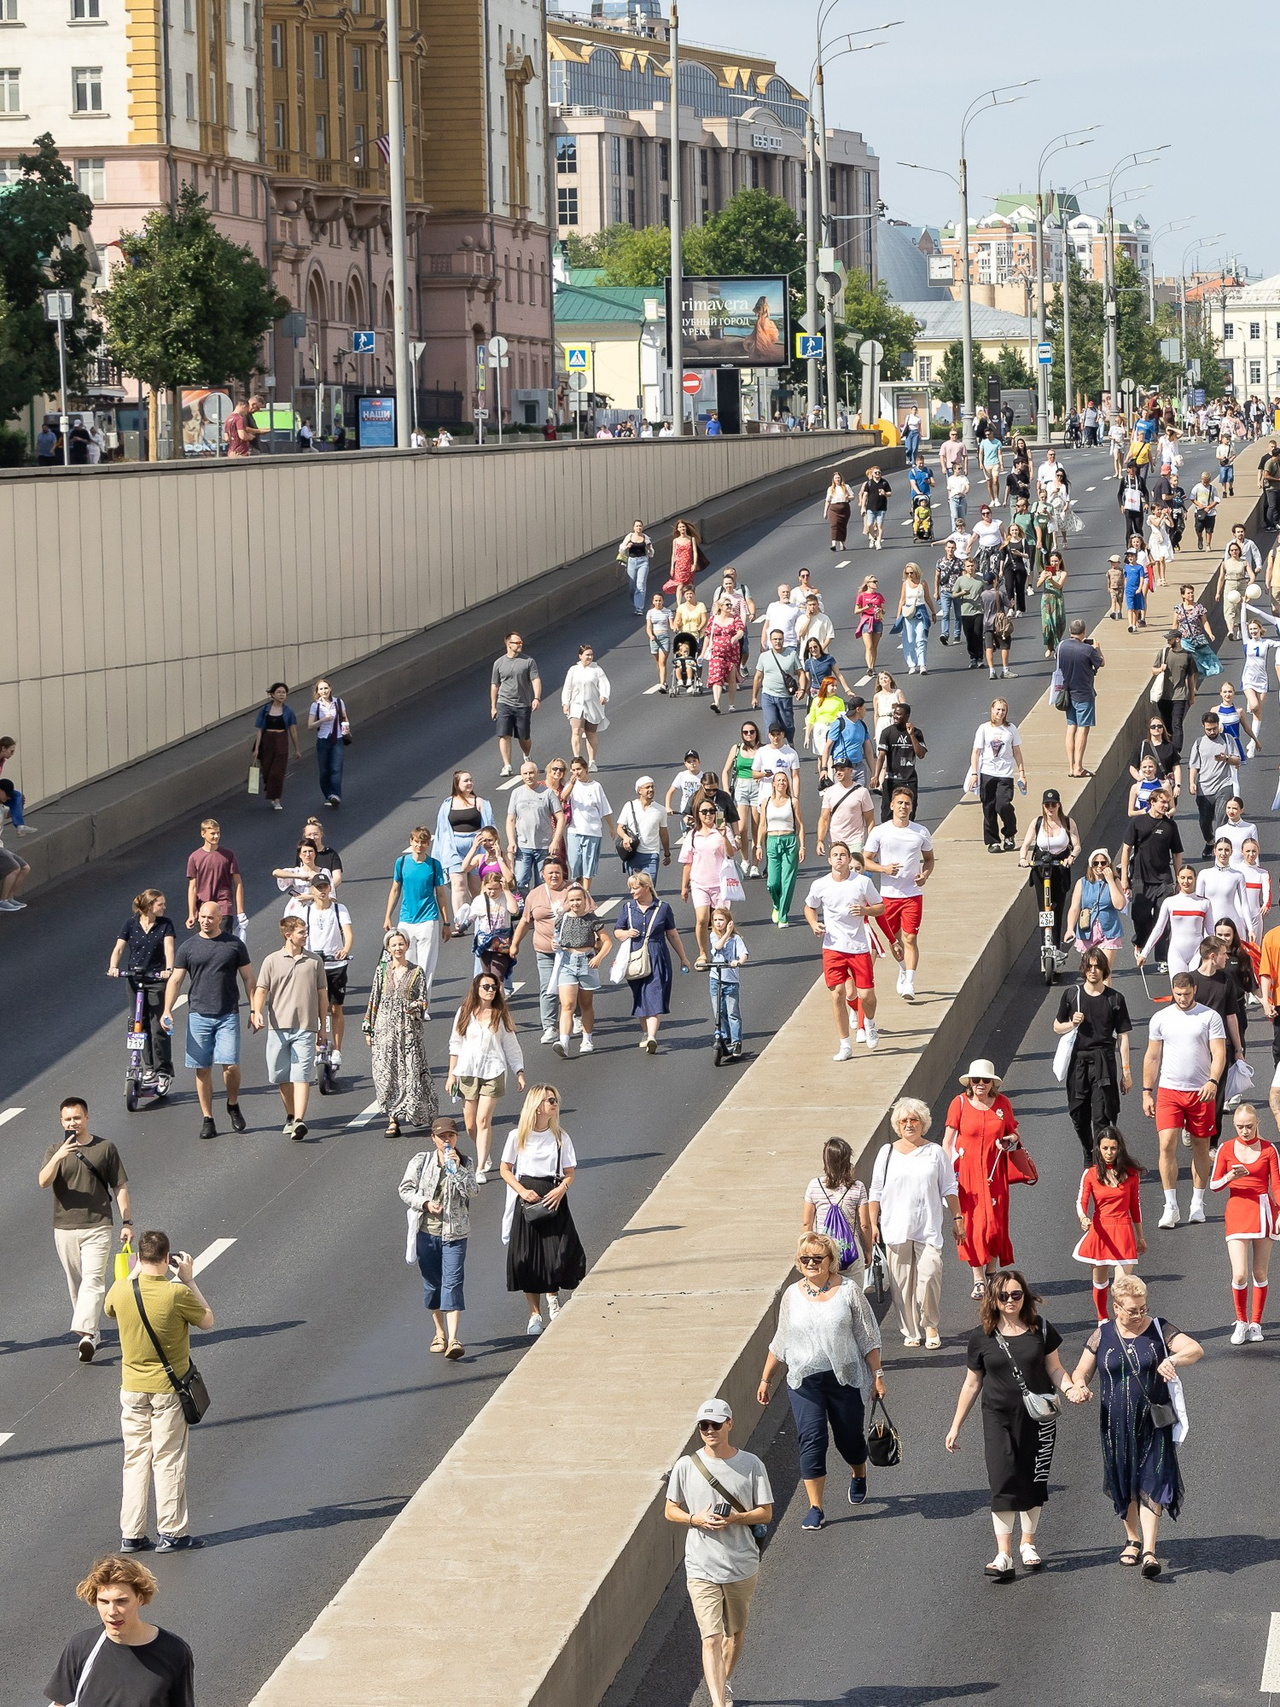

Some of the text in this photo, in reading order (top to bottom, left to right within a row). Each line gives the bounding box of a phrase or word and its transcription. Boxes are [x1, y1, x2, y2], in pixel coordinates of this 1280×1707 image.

[682, 298, 749, 312] rimavera
[682, 316, 750, 327] УБНЫЙ ГОРОД
[688, 328, 711, 336] РЕКЕ
[1253, 646, 1260, 657] 1
